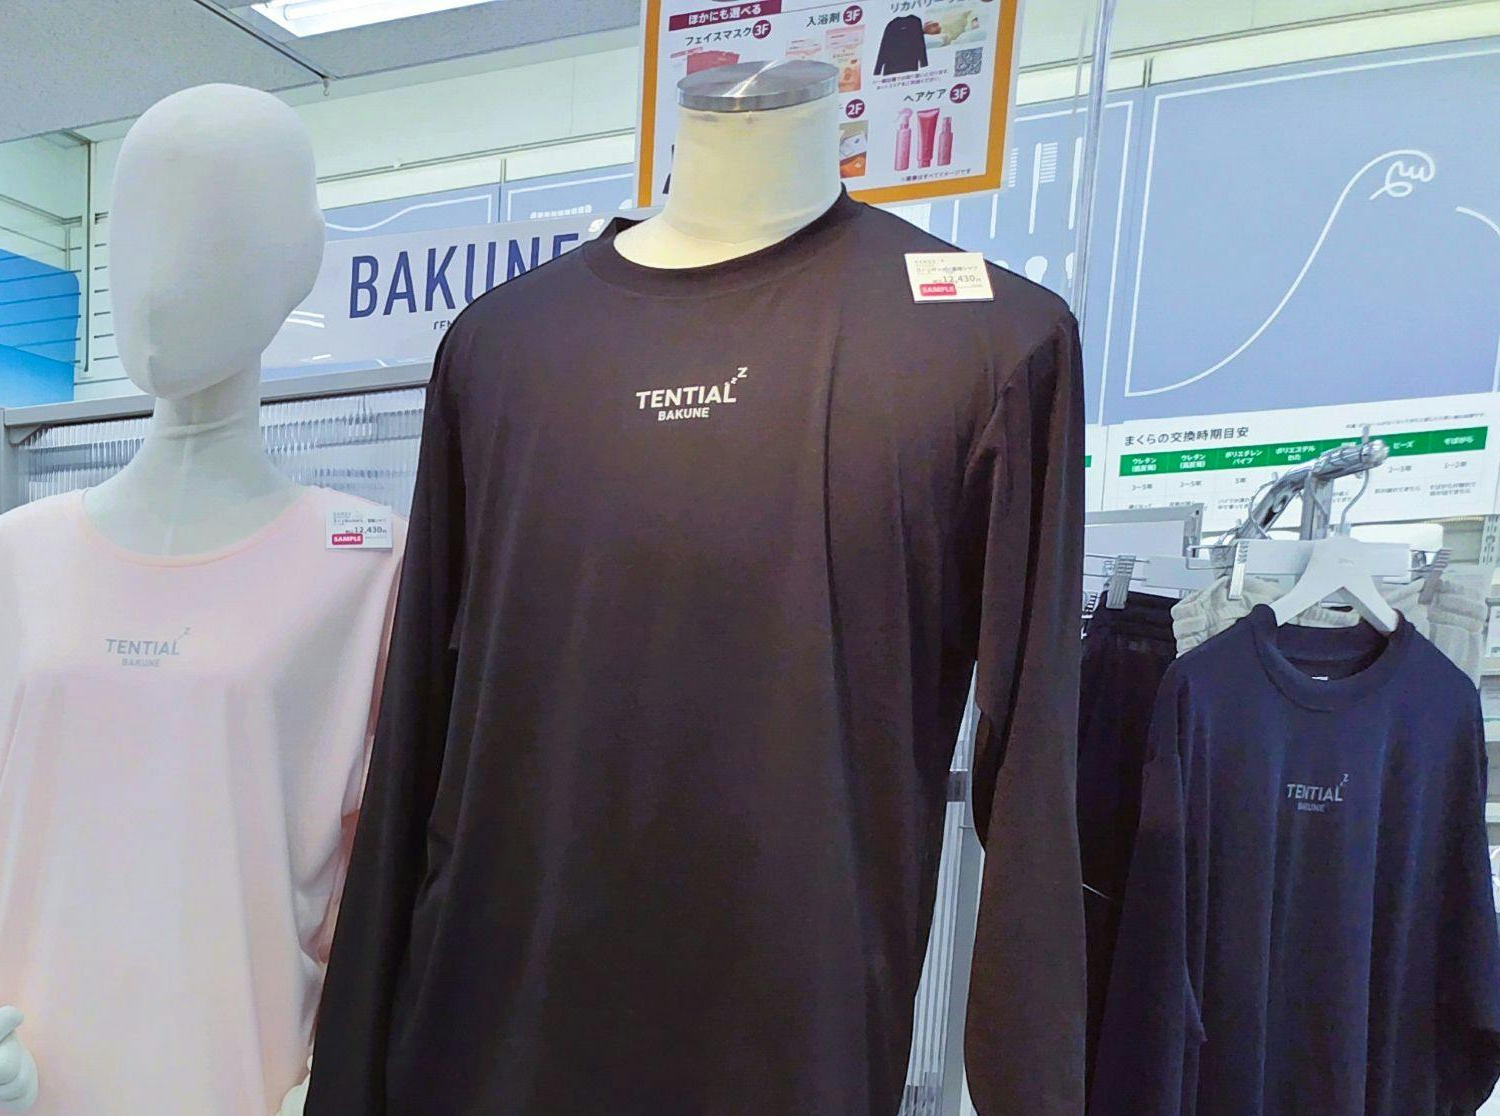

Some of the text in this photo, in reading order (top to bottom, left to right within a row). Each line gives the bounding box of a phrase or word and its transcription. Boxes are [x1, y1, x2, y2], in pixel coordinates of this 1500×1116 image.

[688, 4, 762, 25] ほかにも選べる
[806, 10, 861, 27] 入浴剤 3F
[685, 24, 769, 46] フェイスマスク 3F
[903, 87, 968, 103] ヘアケア 3F
[848, 102, 863, 116] 2F
[635, 381, 737, 410] TENTIAL
[658, 407, 710, 421] BAKUNE
[1124, 426, 1249, 446] まくらの交換時期目安
[104, 638, 181, 656] TENTIAL
[1286, 783, 1344, 803] TENTIAL
